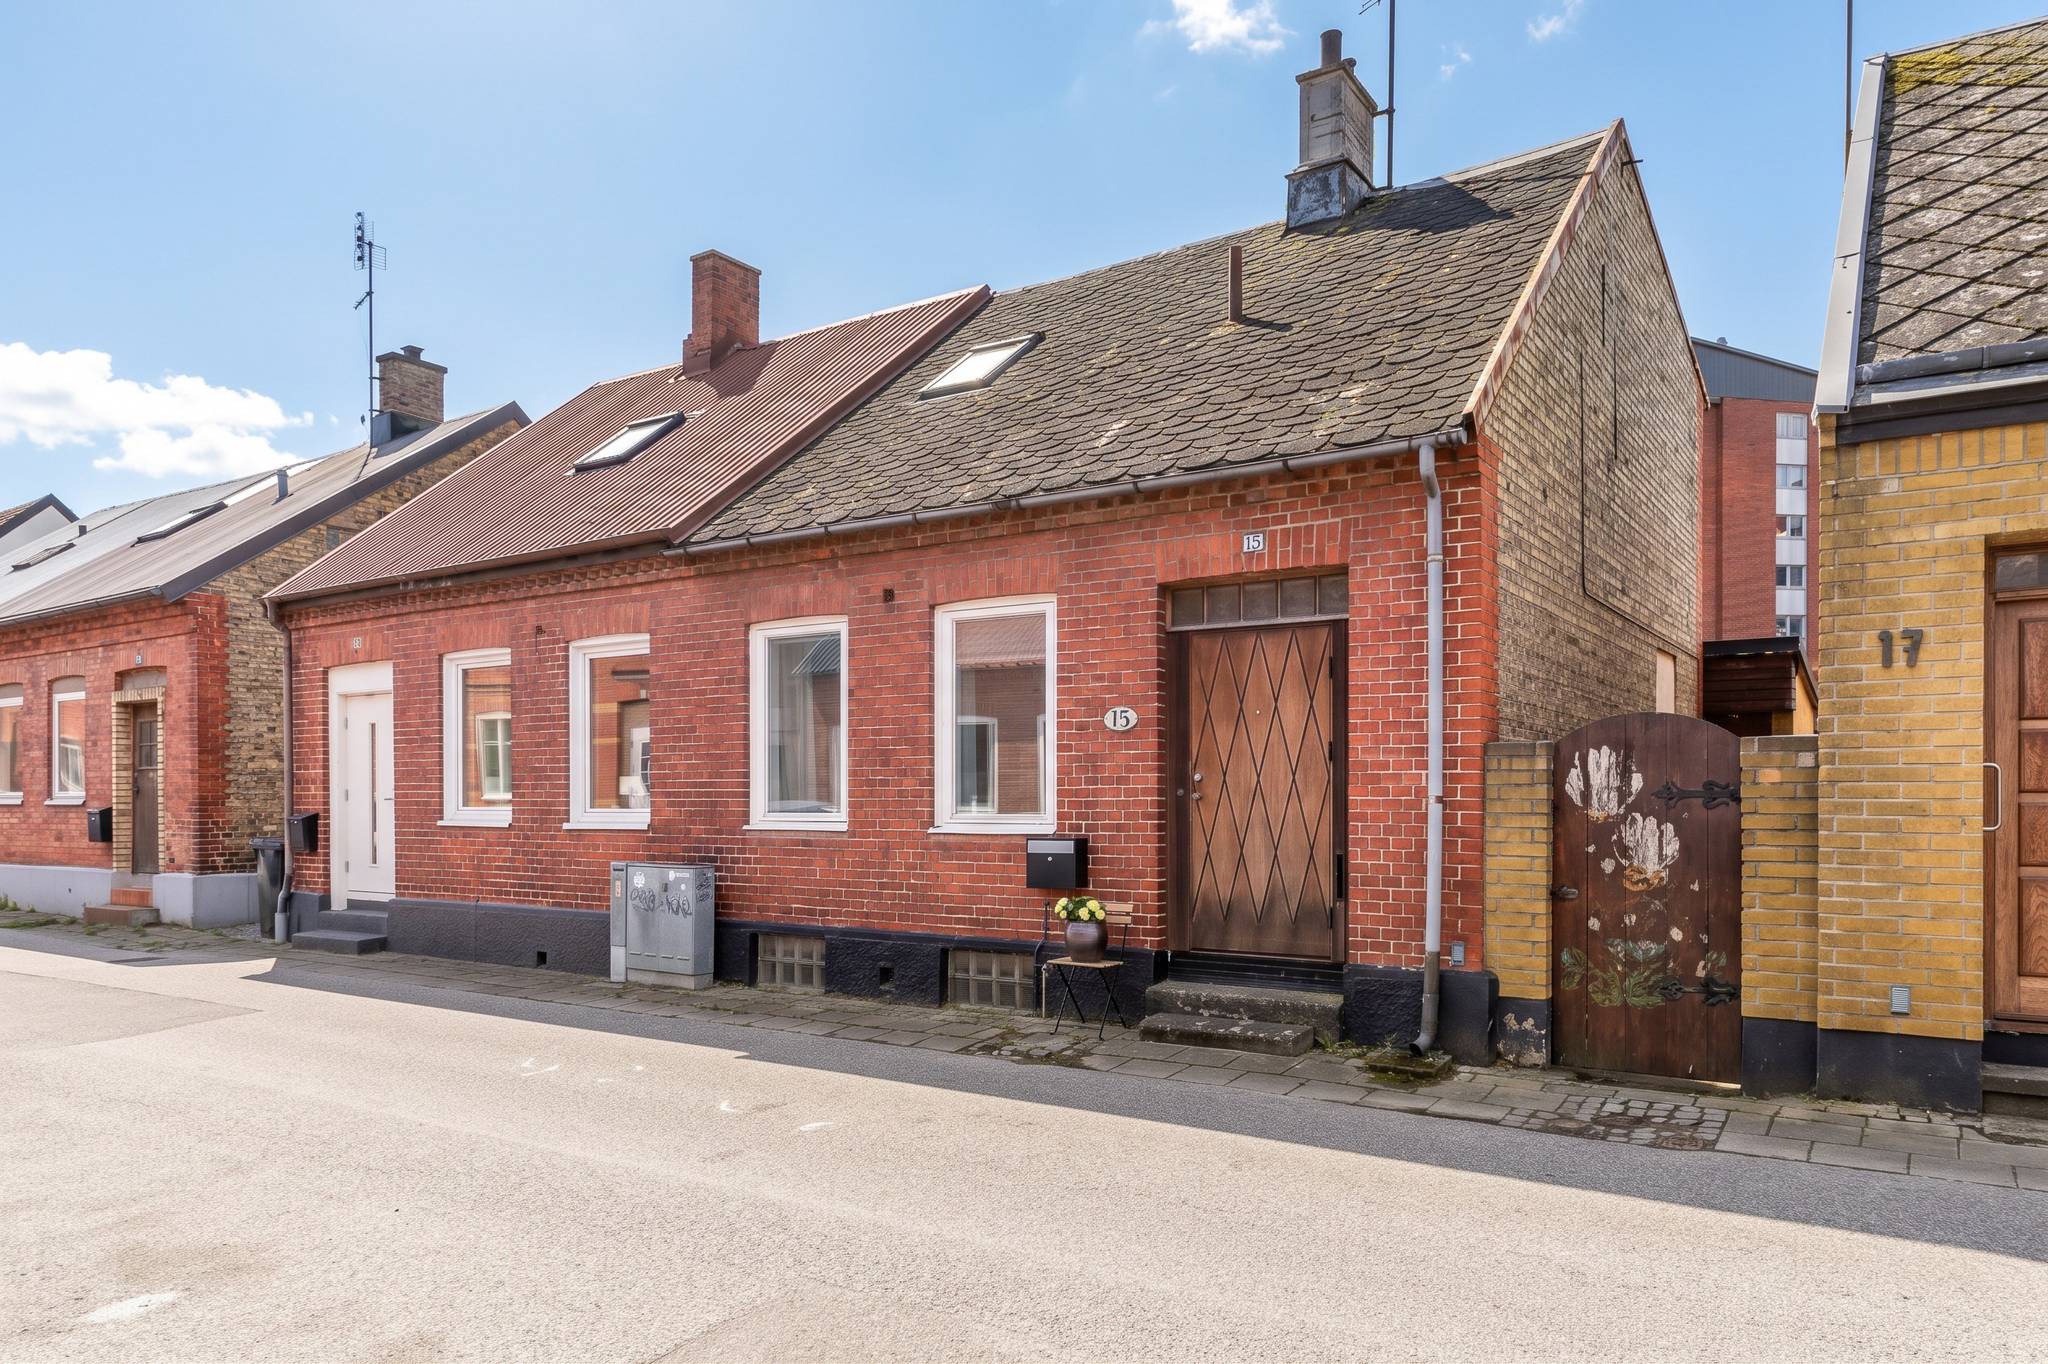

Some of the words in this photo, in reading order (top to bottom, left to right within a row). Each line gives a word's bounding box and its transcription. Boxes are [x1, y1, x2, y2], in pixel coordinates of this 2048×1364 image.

[1246, 535, 1261, 550] 15
[1878, 629, 1923, 668] 17
[1111, 710, 1130, 728] 15
